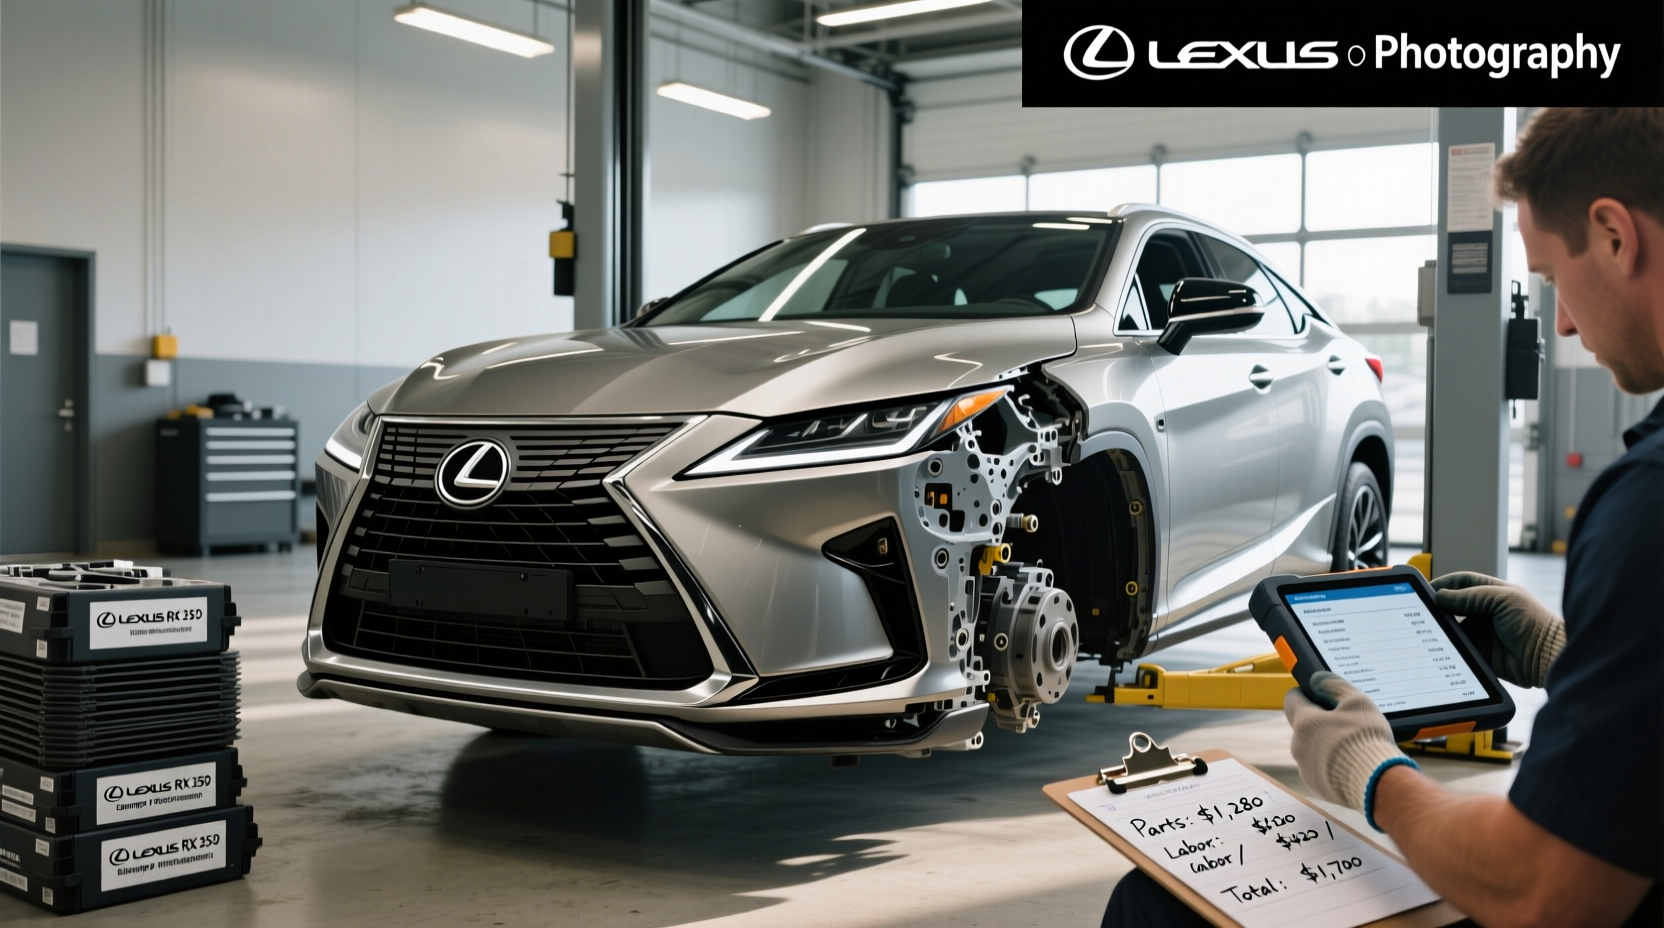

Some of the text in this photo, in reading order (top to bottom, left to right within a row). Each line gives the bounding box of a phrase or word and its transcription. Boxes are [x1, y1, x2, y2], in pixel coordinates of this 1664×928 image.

[118, 612, 165, 625] LEXUS
[126, 781, 172, 797] LEXUS
[1129, 796, 1264, 838] Parts: $1,280
[132, 842, 180, 860] LEXUS
[1220, 856, 1363, 904] Total: $1,700
